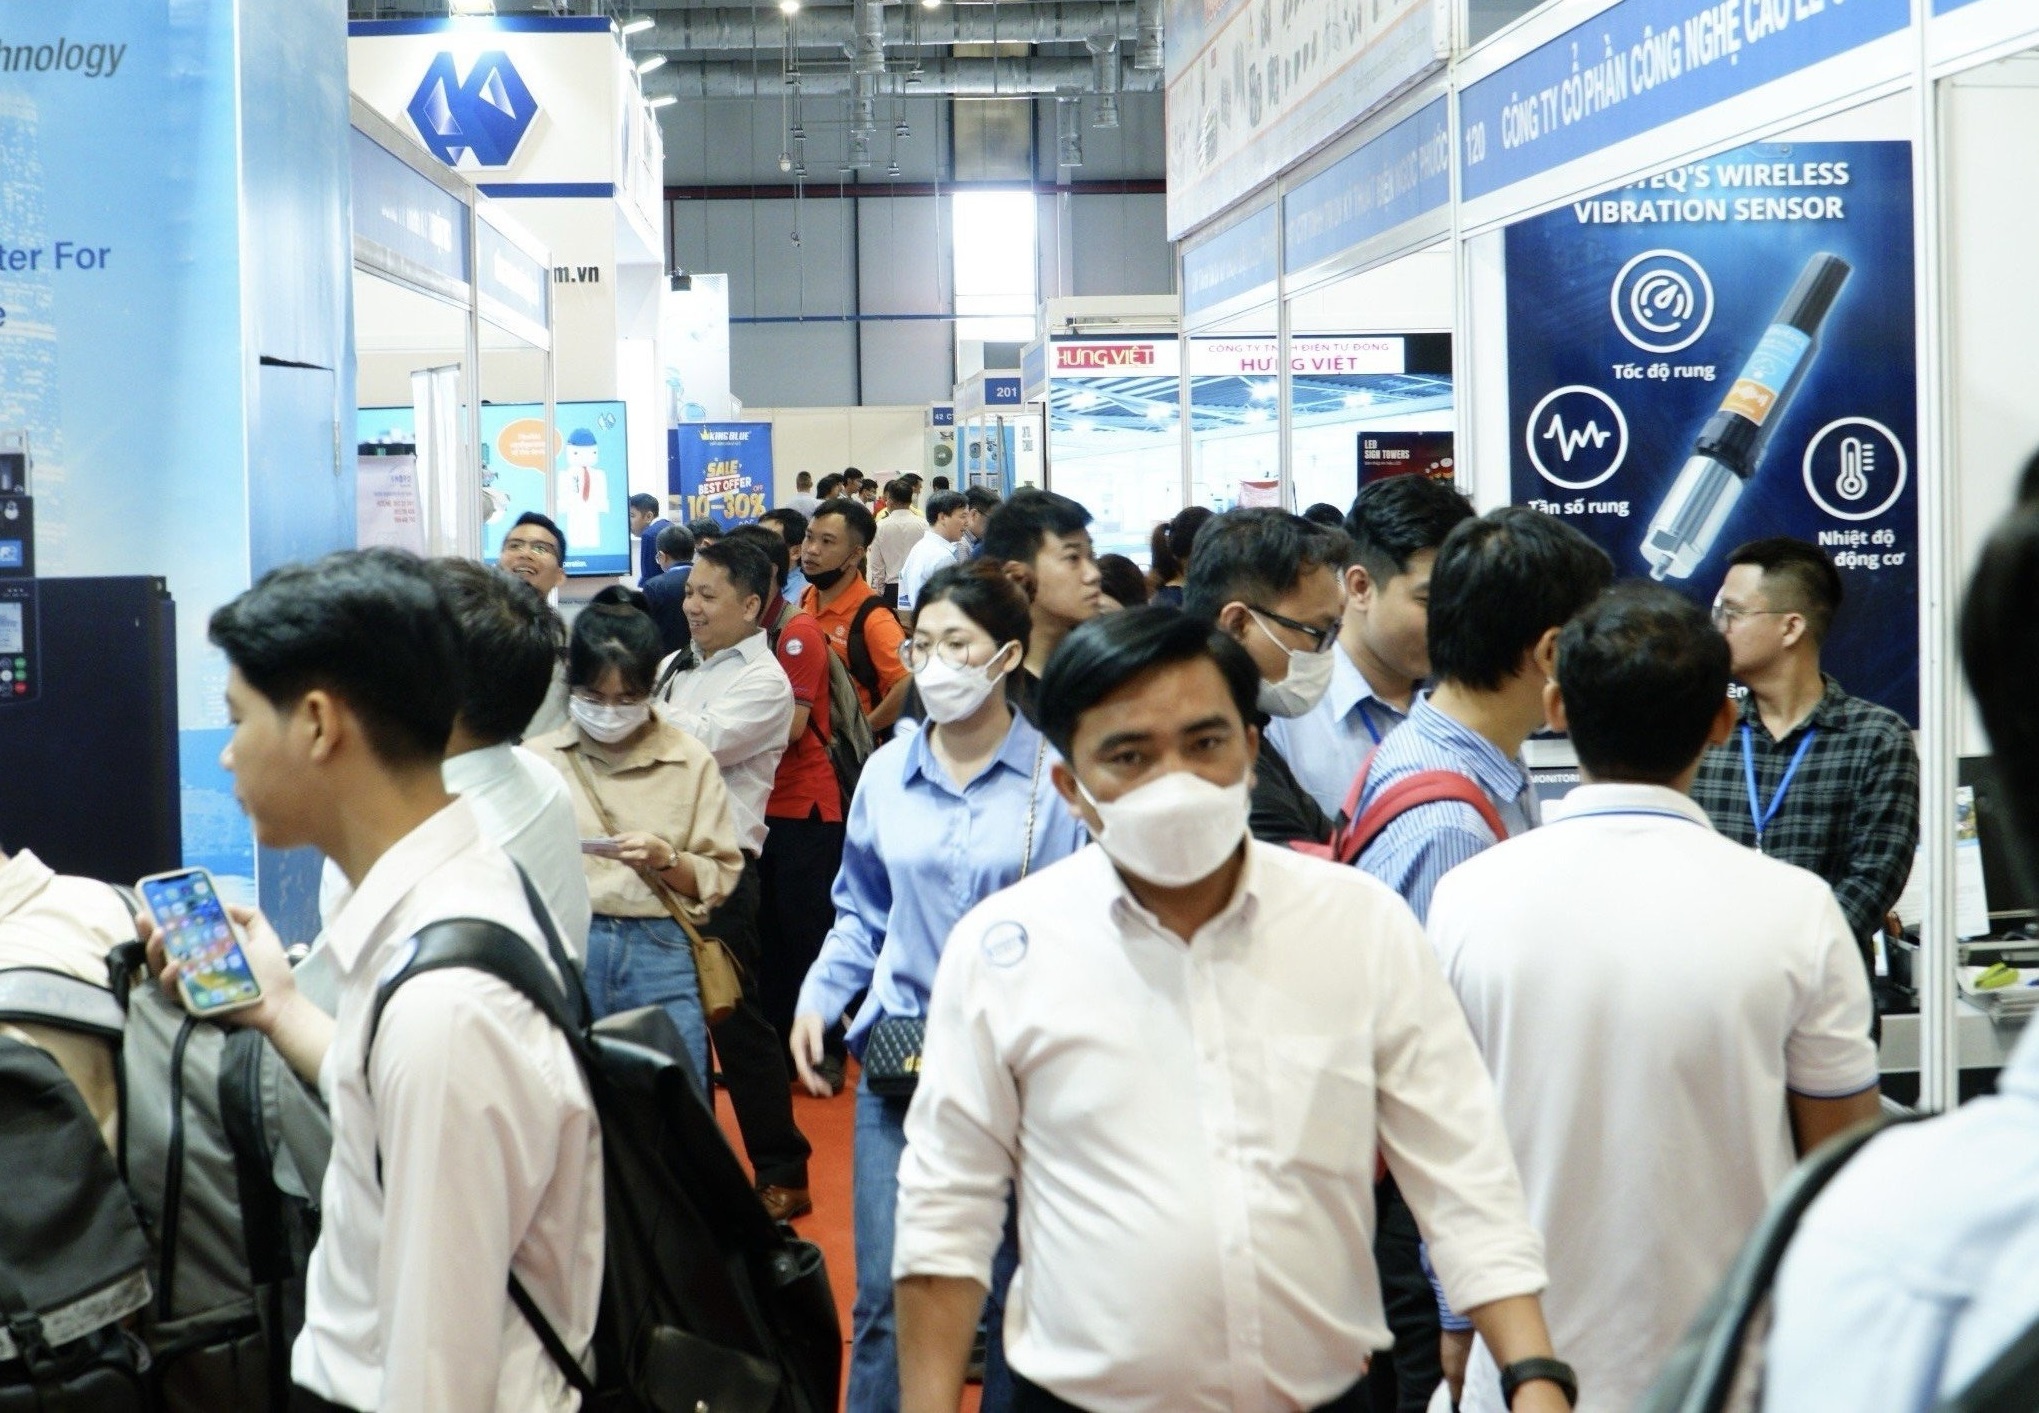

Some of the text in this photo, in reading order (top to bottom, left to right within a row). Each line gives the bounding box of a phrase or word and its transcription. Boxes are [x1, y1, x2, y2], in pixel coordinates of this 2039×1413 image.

[1466, 121, 1486, 167] 120
[1502, 92, 1539, 149] CÔNG
[1540, 86, 1559, 134] TY
[1561, 42, 1584, 126] CỔ
[1584, 34, 1628, 116] PHẦN
[1630, 25, 1682, 95] CÔNG
[1624, 162, 1850, 193] EQ'S WIRELESS
[1573, 197, 1844, 224] VIBRATION SENSOR
[55, 241, 112, 270] For
[1264, 344, 1298, 352] TNH
[1241, 356, 1305, 371] HƯG
[1612, 362, 1717, 382] Tốc độ rung
[996, 387, 1018, 398] 201
[1364, 439, 1378, 450] LED
[1364, 449, 1410, 460] SIGN TOWERS
[706, 460, 739, 478] SALE
[698, 476, 752, 496] BEST OFFER
[1563, 498, 1586, 515] số
[1587, 501, 1630, 518] rung
[1818, 528, 1896, 549] Nhiệt độ
[1834, 550, 1906, 570] động cơ
